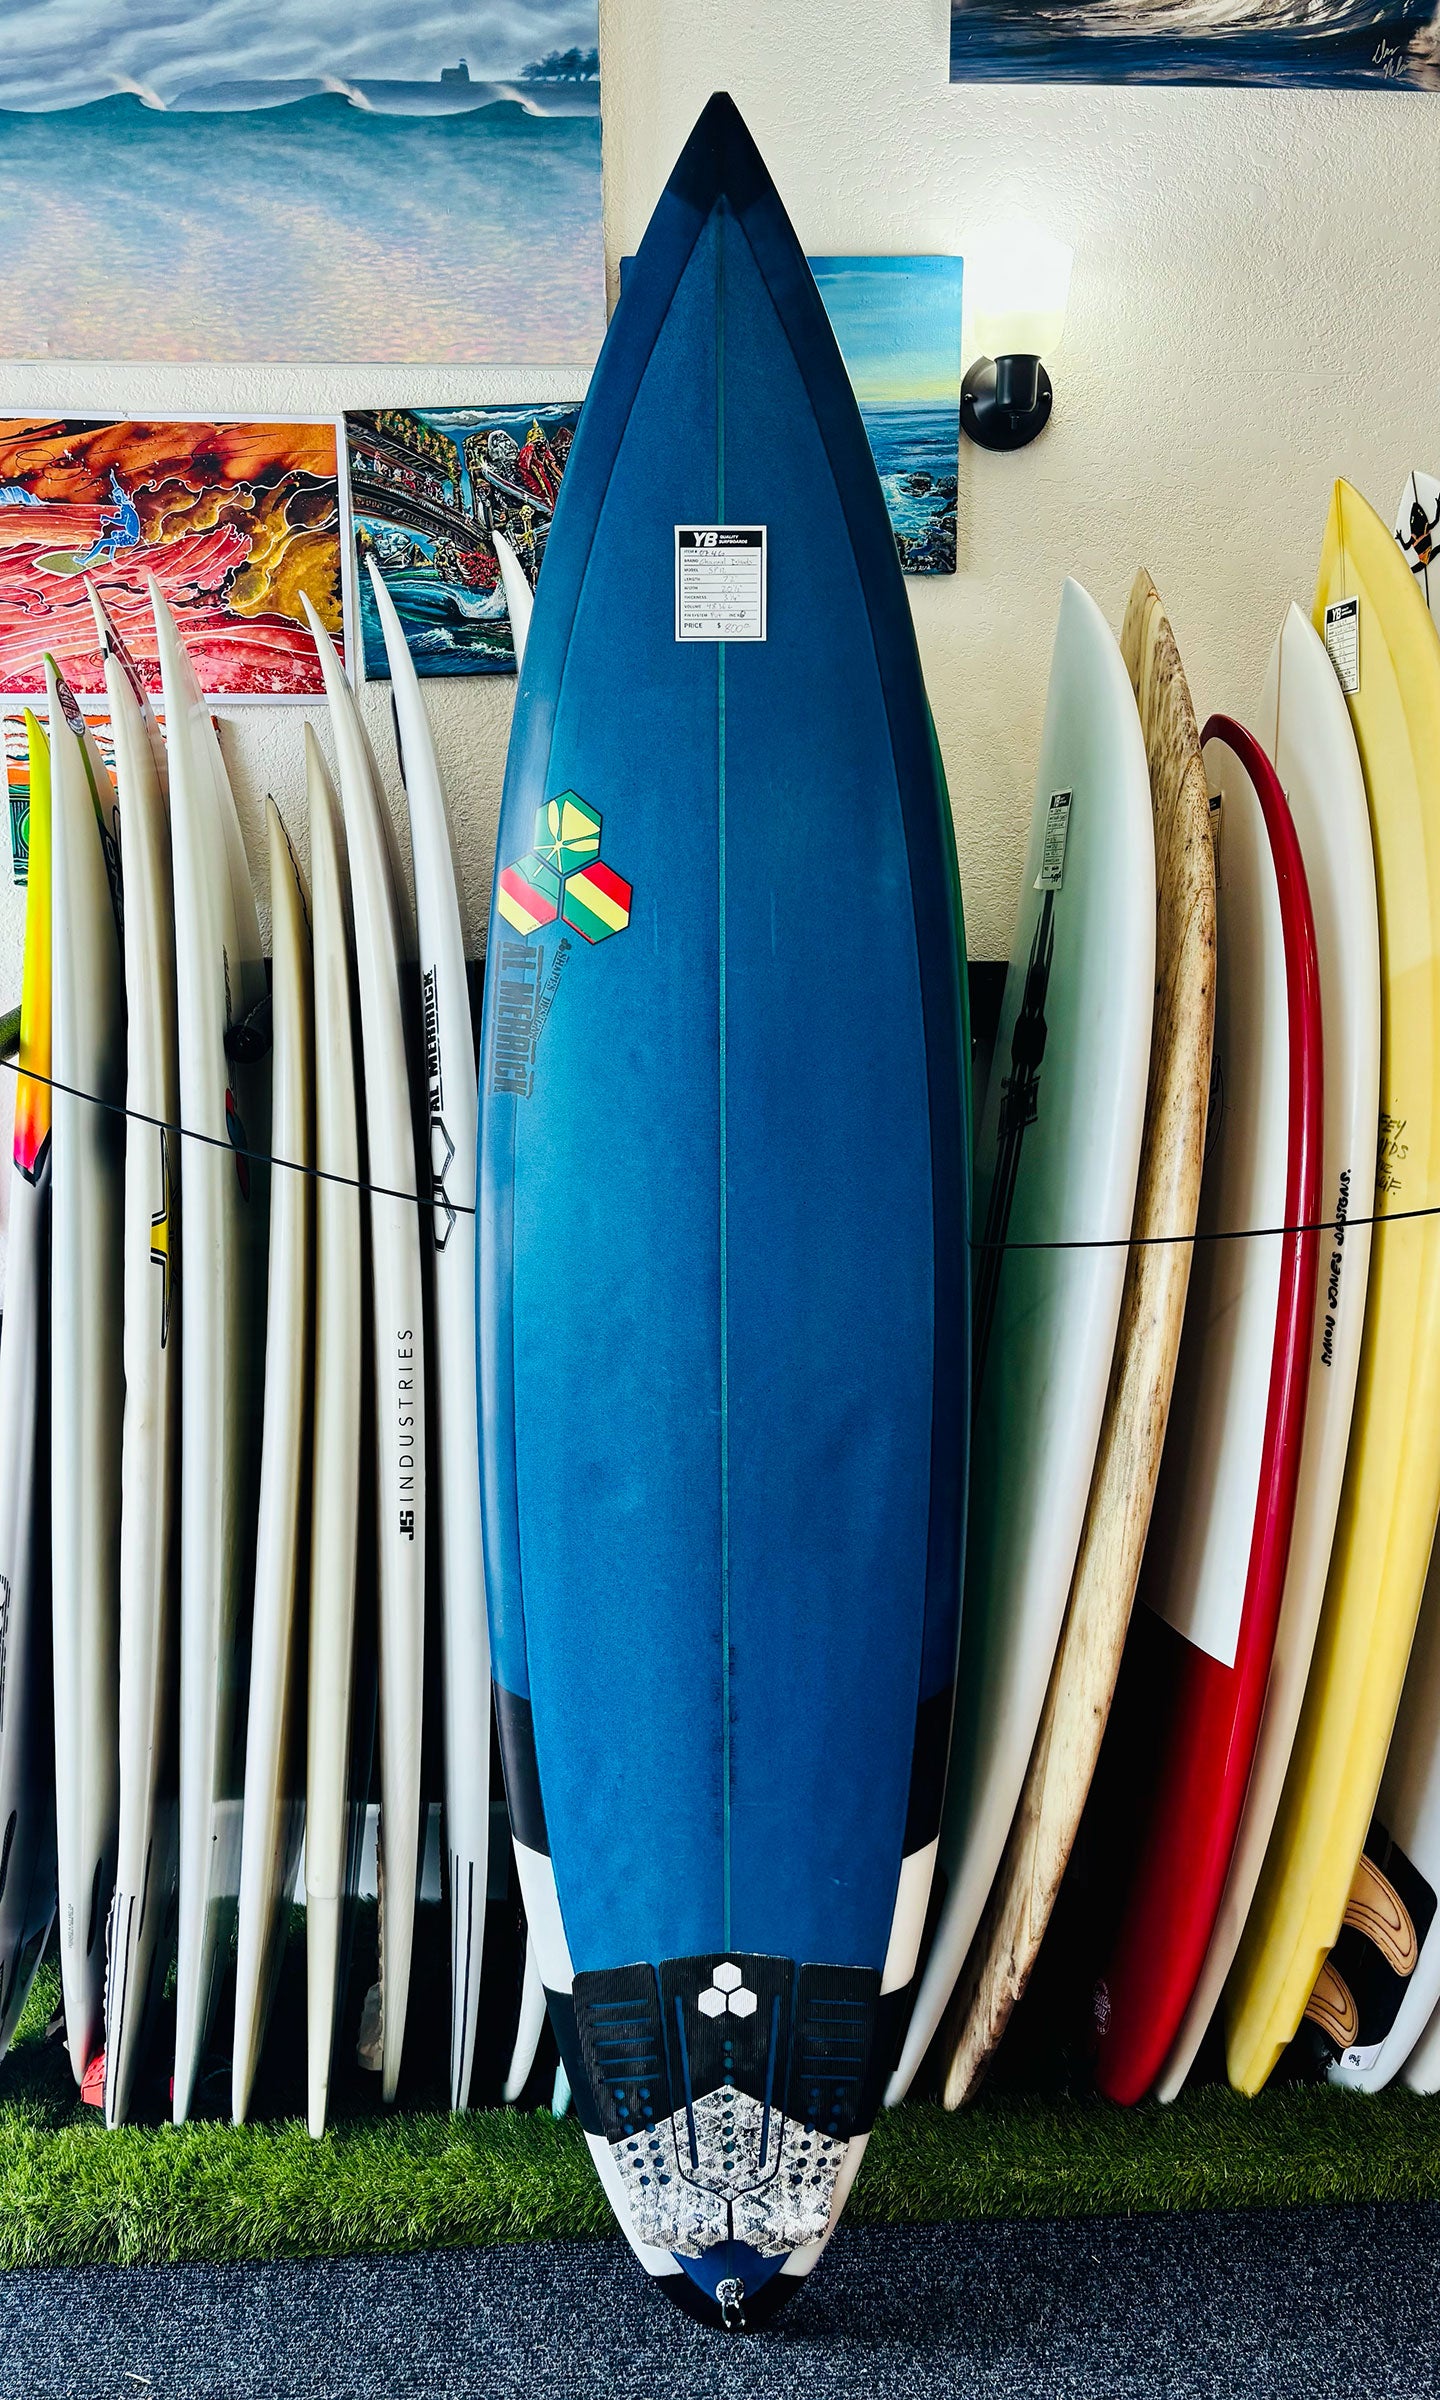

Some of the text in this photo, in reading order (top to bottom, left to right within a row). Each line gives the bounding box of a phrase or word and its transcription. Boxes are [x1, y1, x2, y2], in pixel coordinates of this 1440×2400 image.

[693, 532, 718, 547] YB
[423, 970, 441, 1112] AL MERRICK
[493, 941, 537, 1097] AL MERRICK
[1329, 1251, 1343, 1310] JONES
[397, 1329, 415, 1541] JS INDUSTRIES
